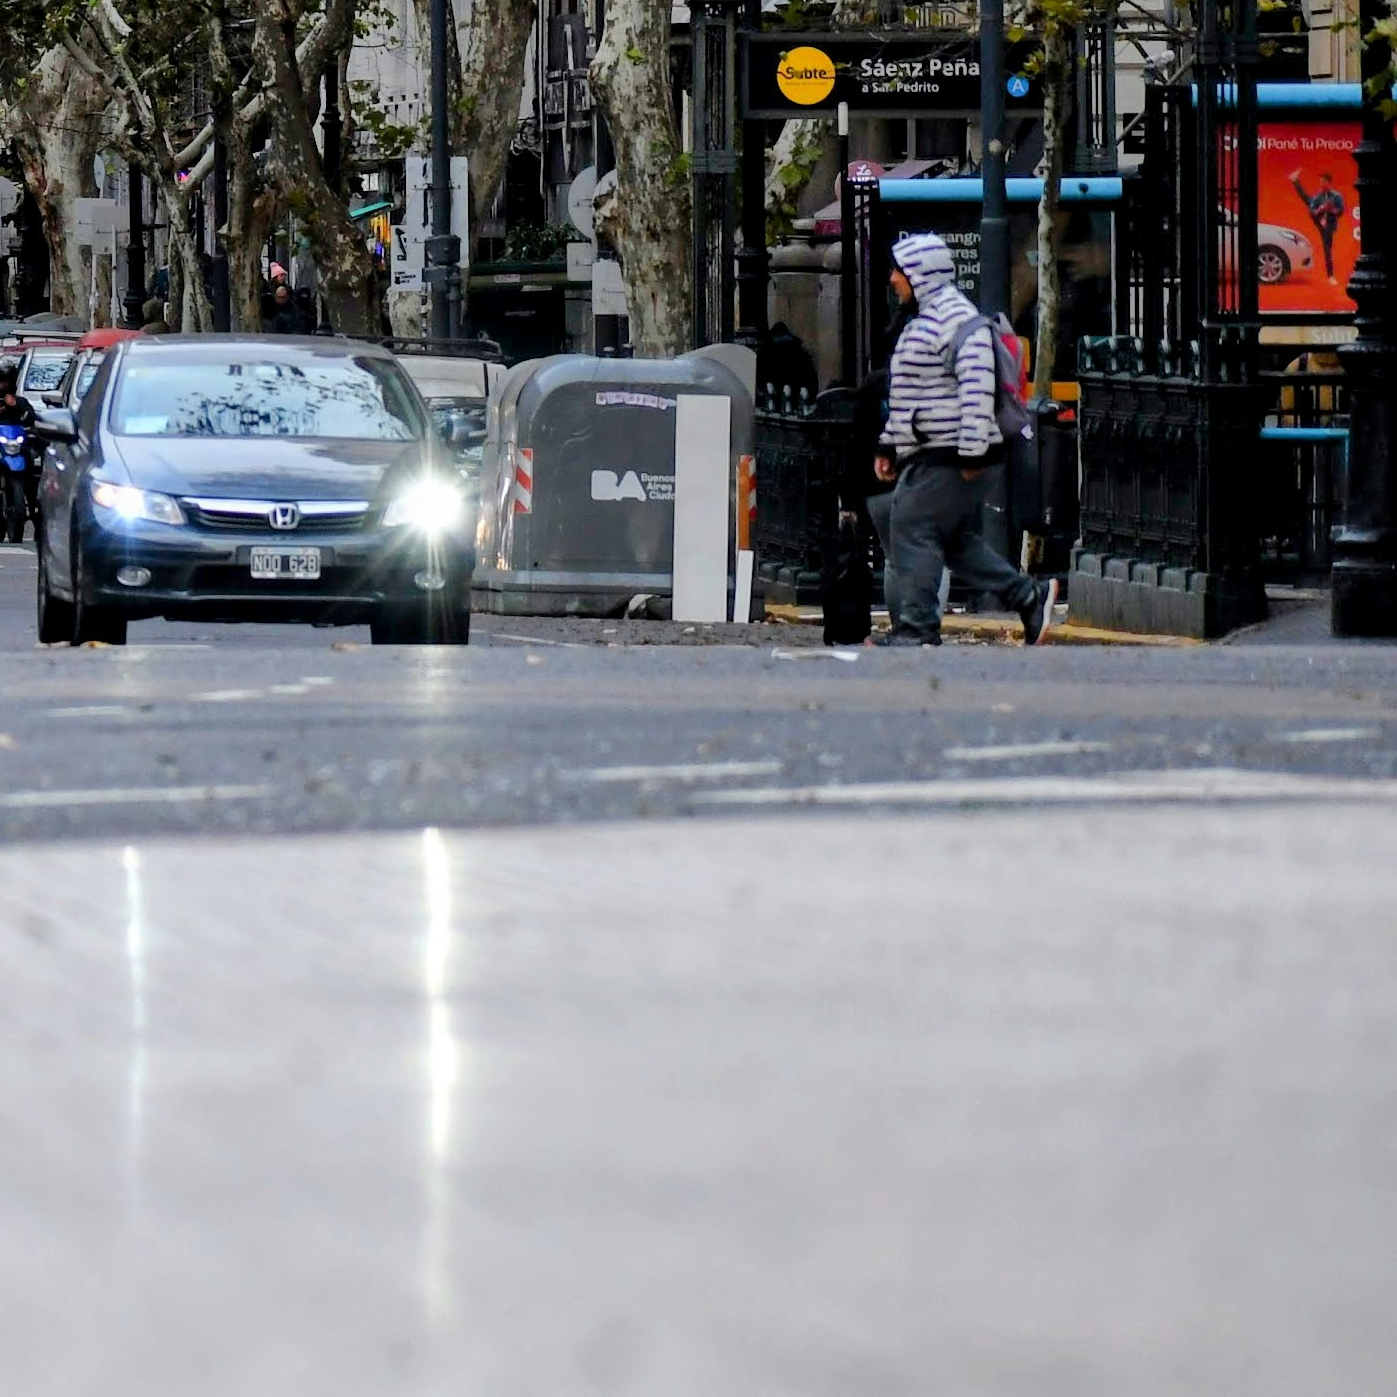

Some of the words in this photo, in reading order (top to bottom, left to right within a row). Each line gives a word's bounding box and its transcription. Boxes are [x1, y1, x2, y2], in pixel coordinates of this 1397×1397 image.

[930, 58, 980, 77] Peña
[896, 82, 940, 93] Pedrito
[1267, 137, 1297, 149] Poné
[1301, 137, 1313, 149] Tu
[1316, 137, 1353, 149] Precio
[640, 472, 676, 482] Buenos
[591, 469, 646, 502] BA
[646, 483, 673, 491] Aires
[289, 554, 317, 572] 628
